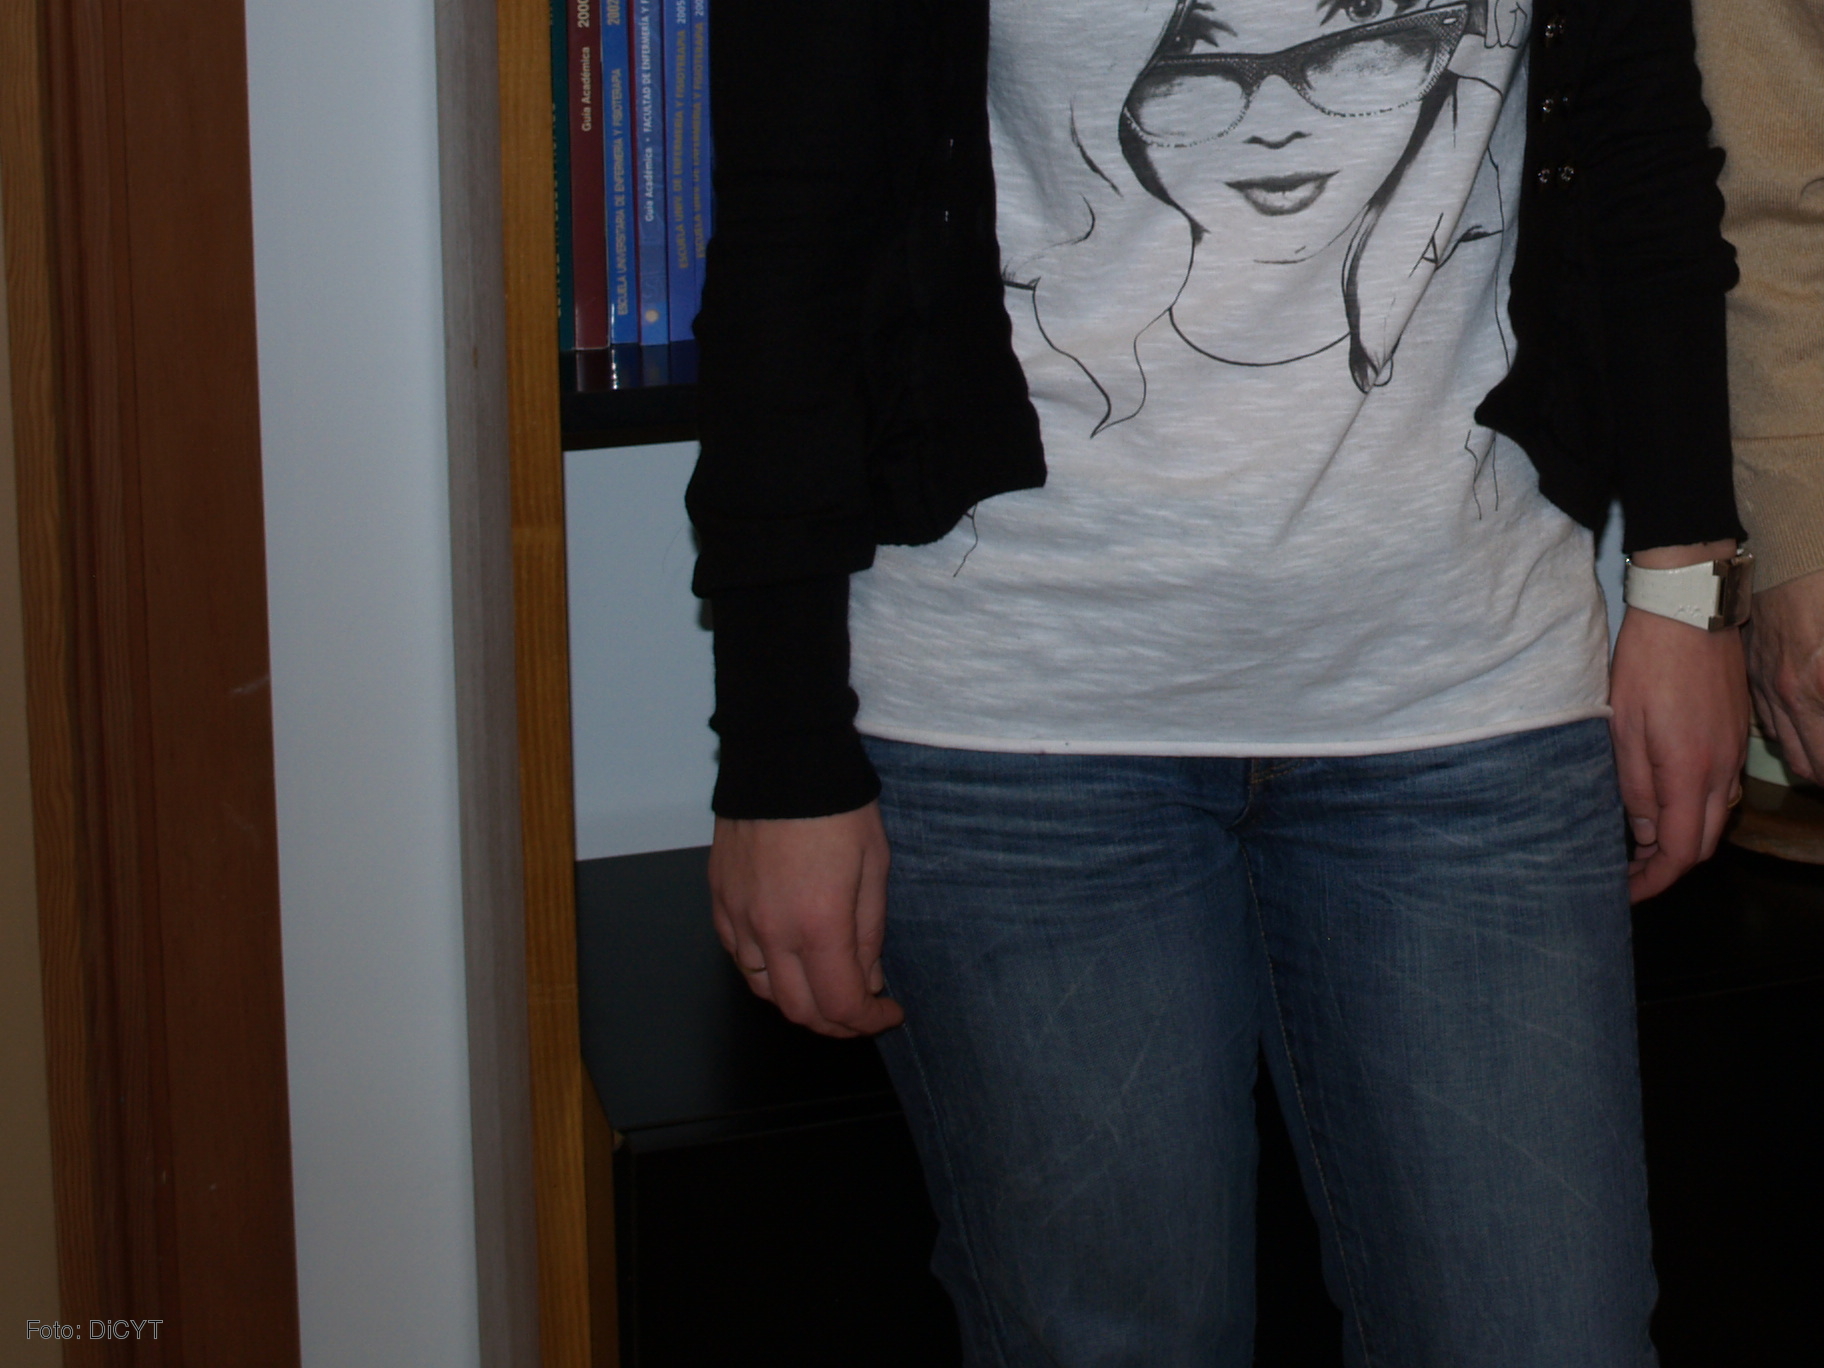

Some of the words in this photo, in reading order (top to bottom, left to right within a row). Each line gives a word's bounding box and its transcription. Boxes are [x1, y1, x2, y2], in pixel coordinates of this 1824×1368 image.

[640, 7, 650, 15] Y
[580, 47, 591, 104] Académica
[641, 71, 651, 84] DE
[642, 85, 652, 132] FACULTAD
[644, 147, 653, 198] Académica
[614, 194, 626, 207] DE
